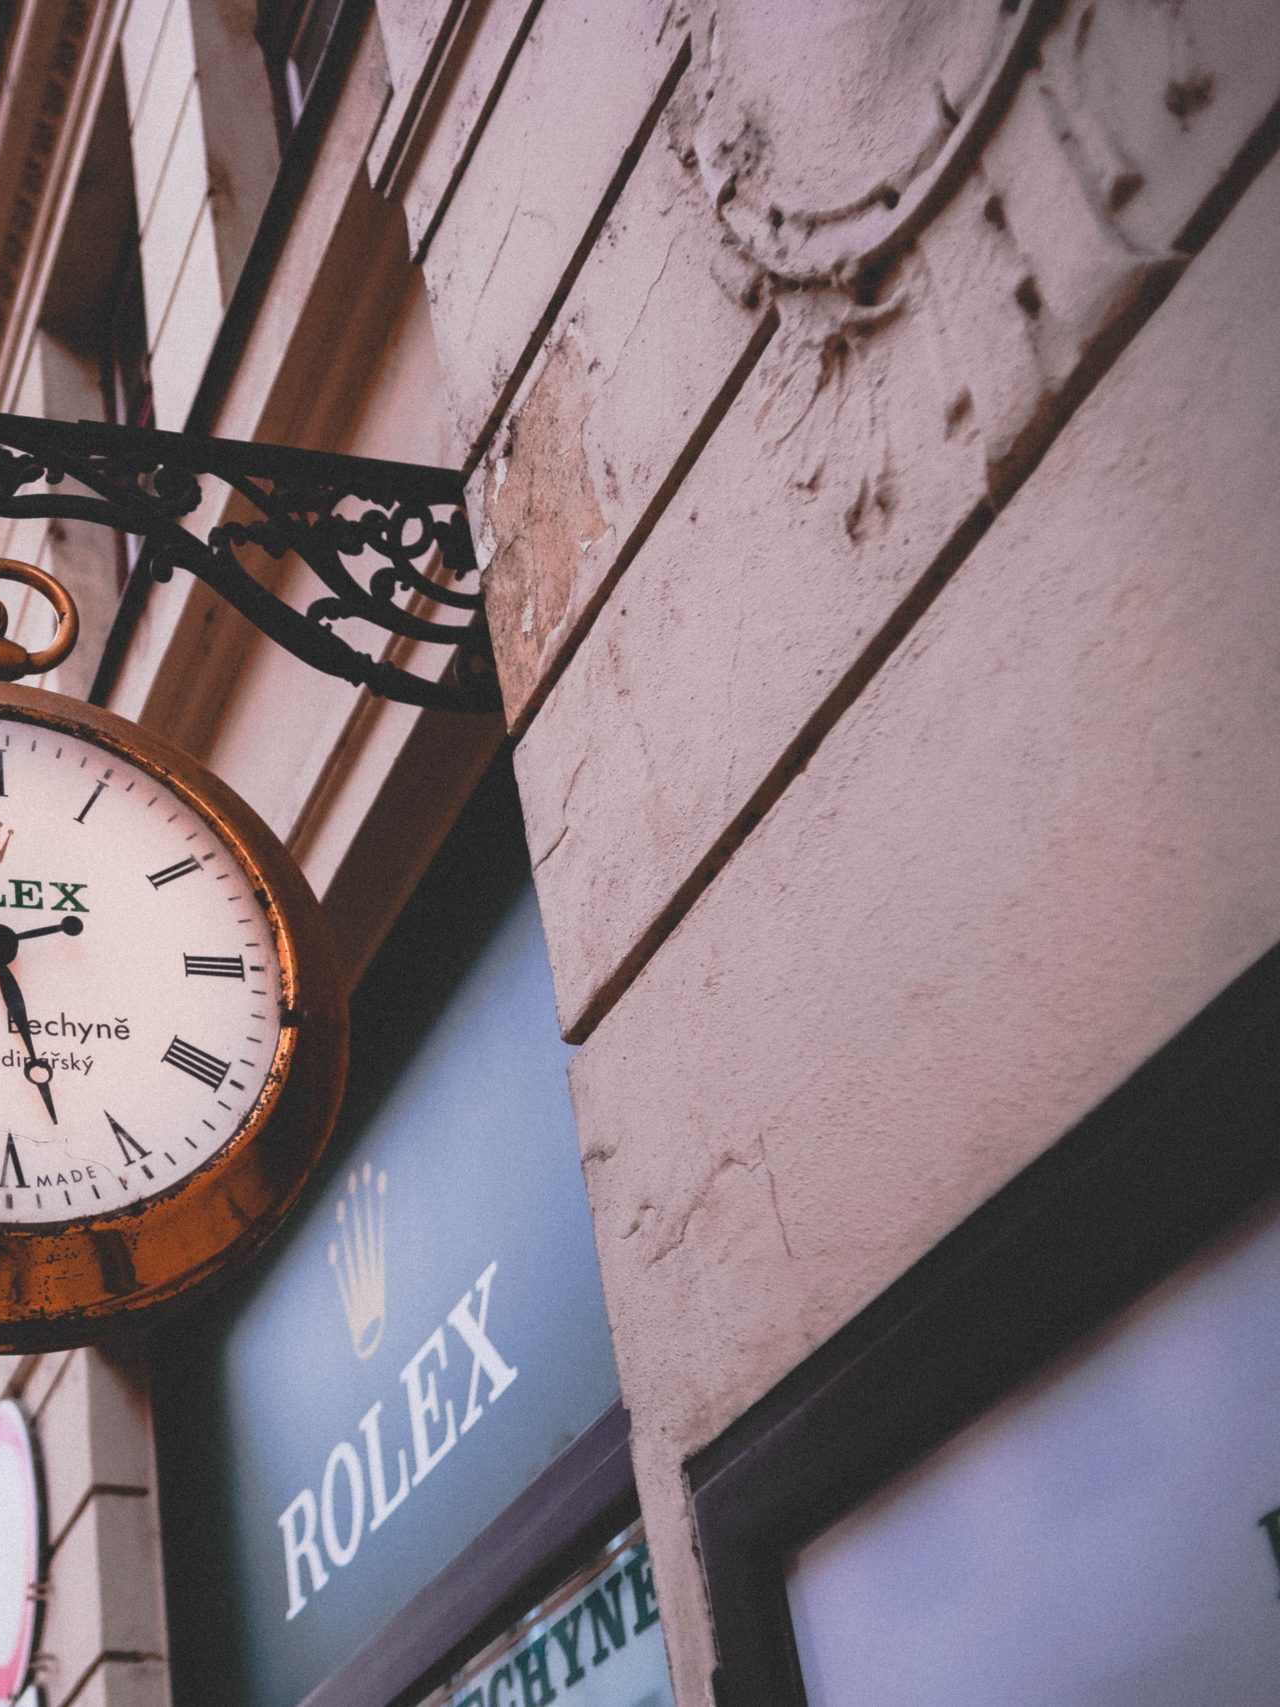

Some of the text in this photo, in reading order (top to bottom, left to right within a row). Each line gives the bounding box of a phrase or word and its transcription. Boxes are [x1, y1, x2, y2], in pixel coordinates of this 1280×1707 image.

[146, 854, 204, 890] II
[183, 952, 245, 981] III
[36, 1165, 97, 1188] MADE
[278, 1260, 518, 1621] ROLEX
